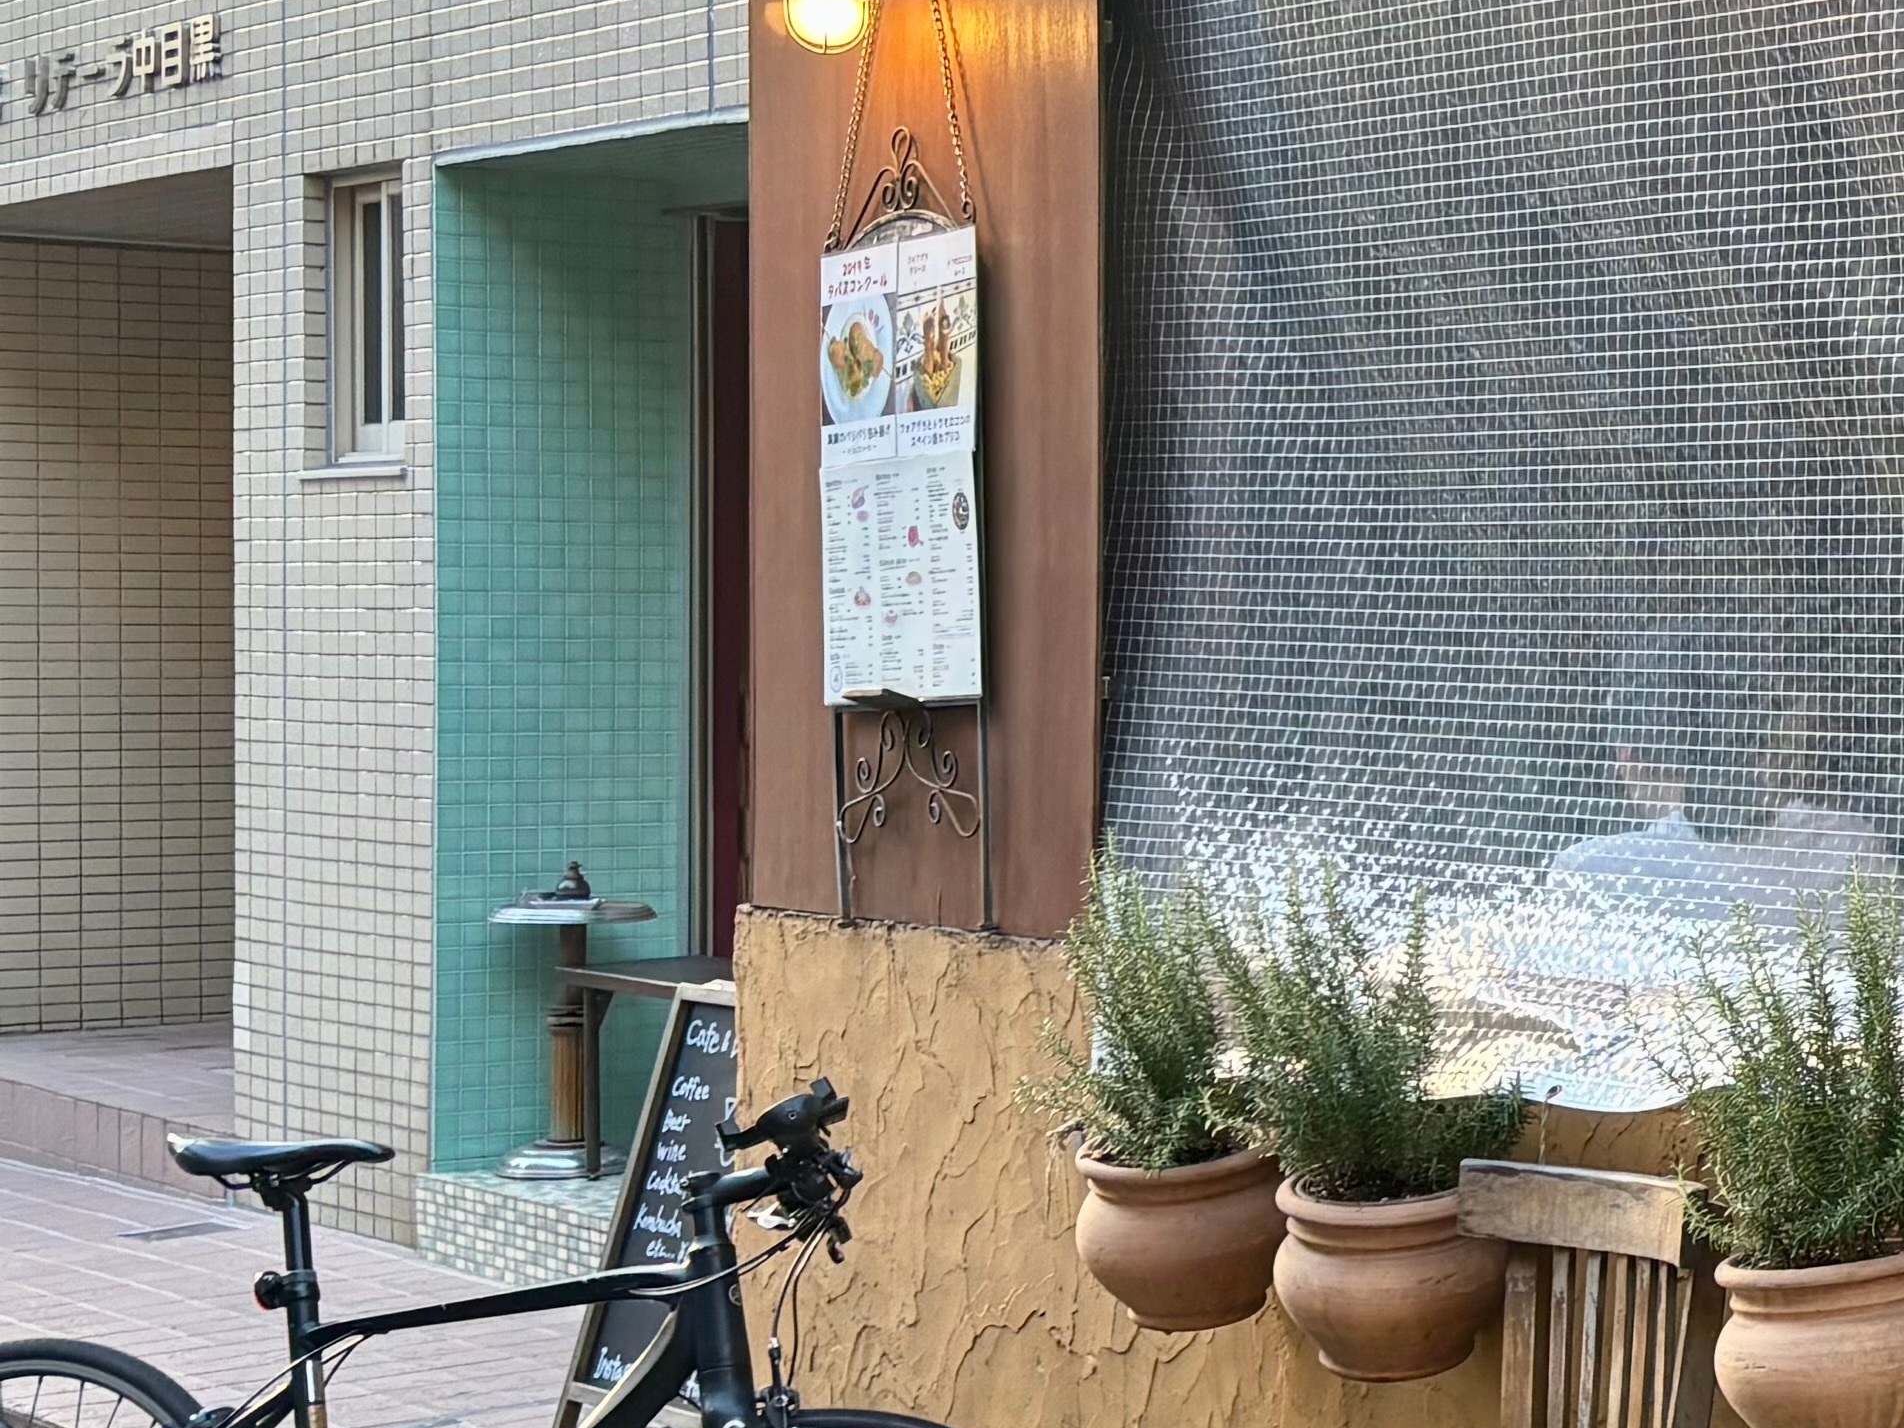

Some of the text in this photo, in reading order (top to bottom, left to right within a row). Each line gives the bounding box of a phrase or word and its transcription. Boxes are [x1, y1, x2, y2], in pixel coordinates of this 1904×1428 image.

[827, 277, 888, 299] タパスコンクール
[671, 1075, 710, 1102] Coffee
